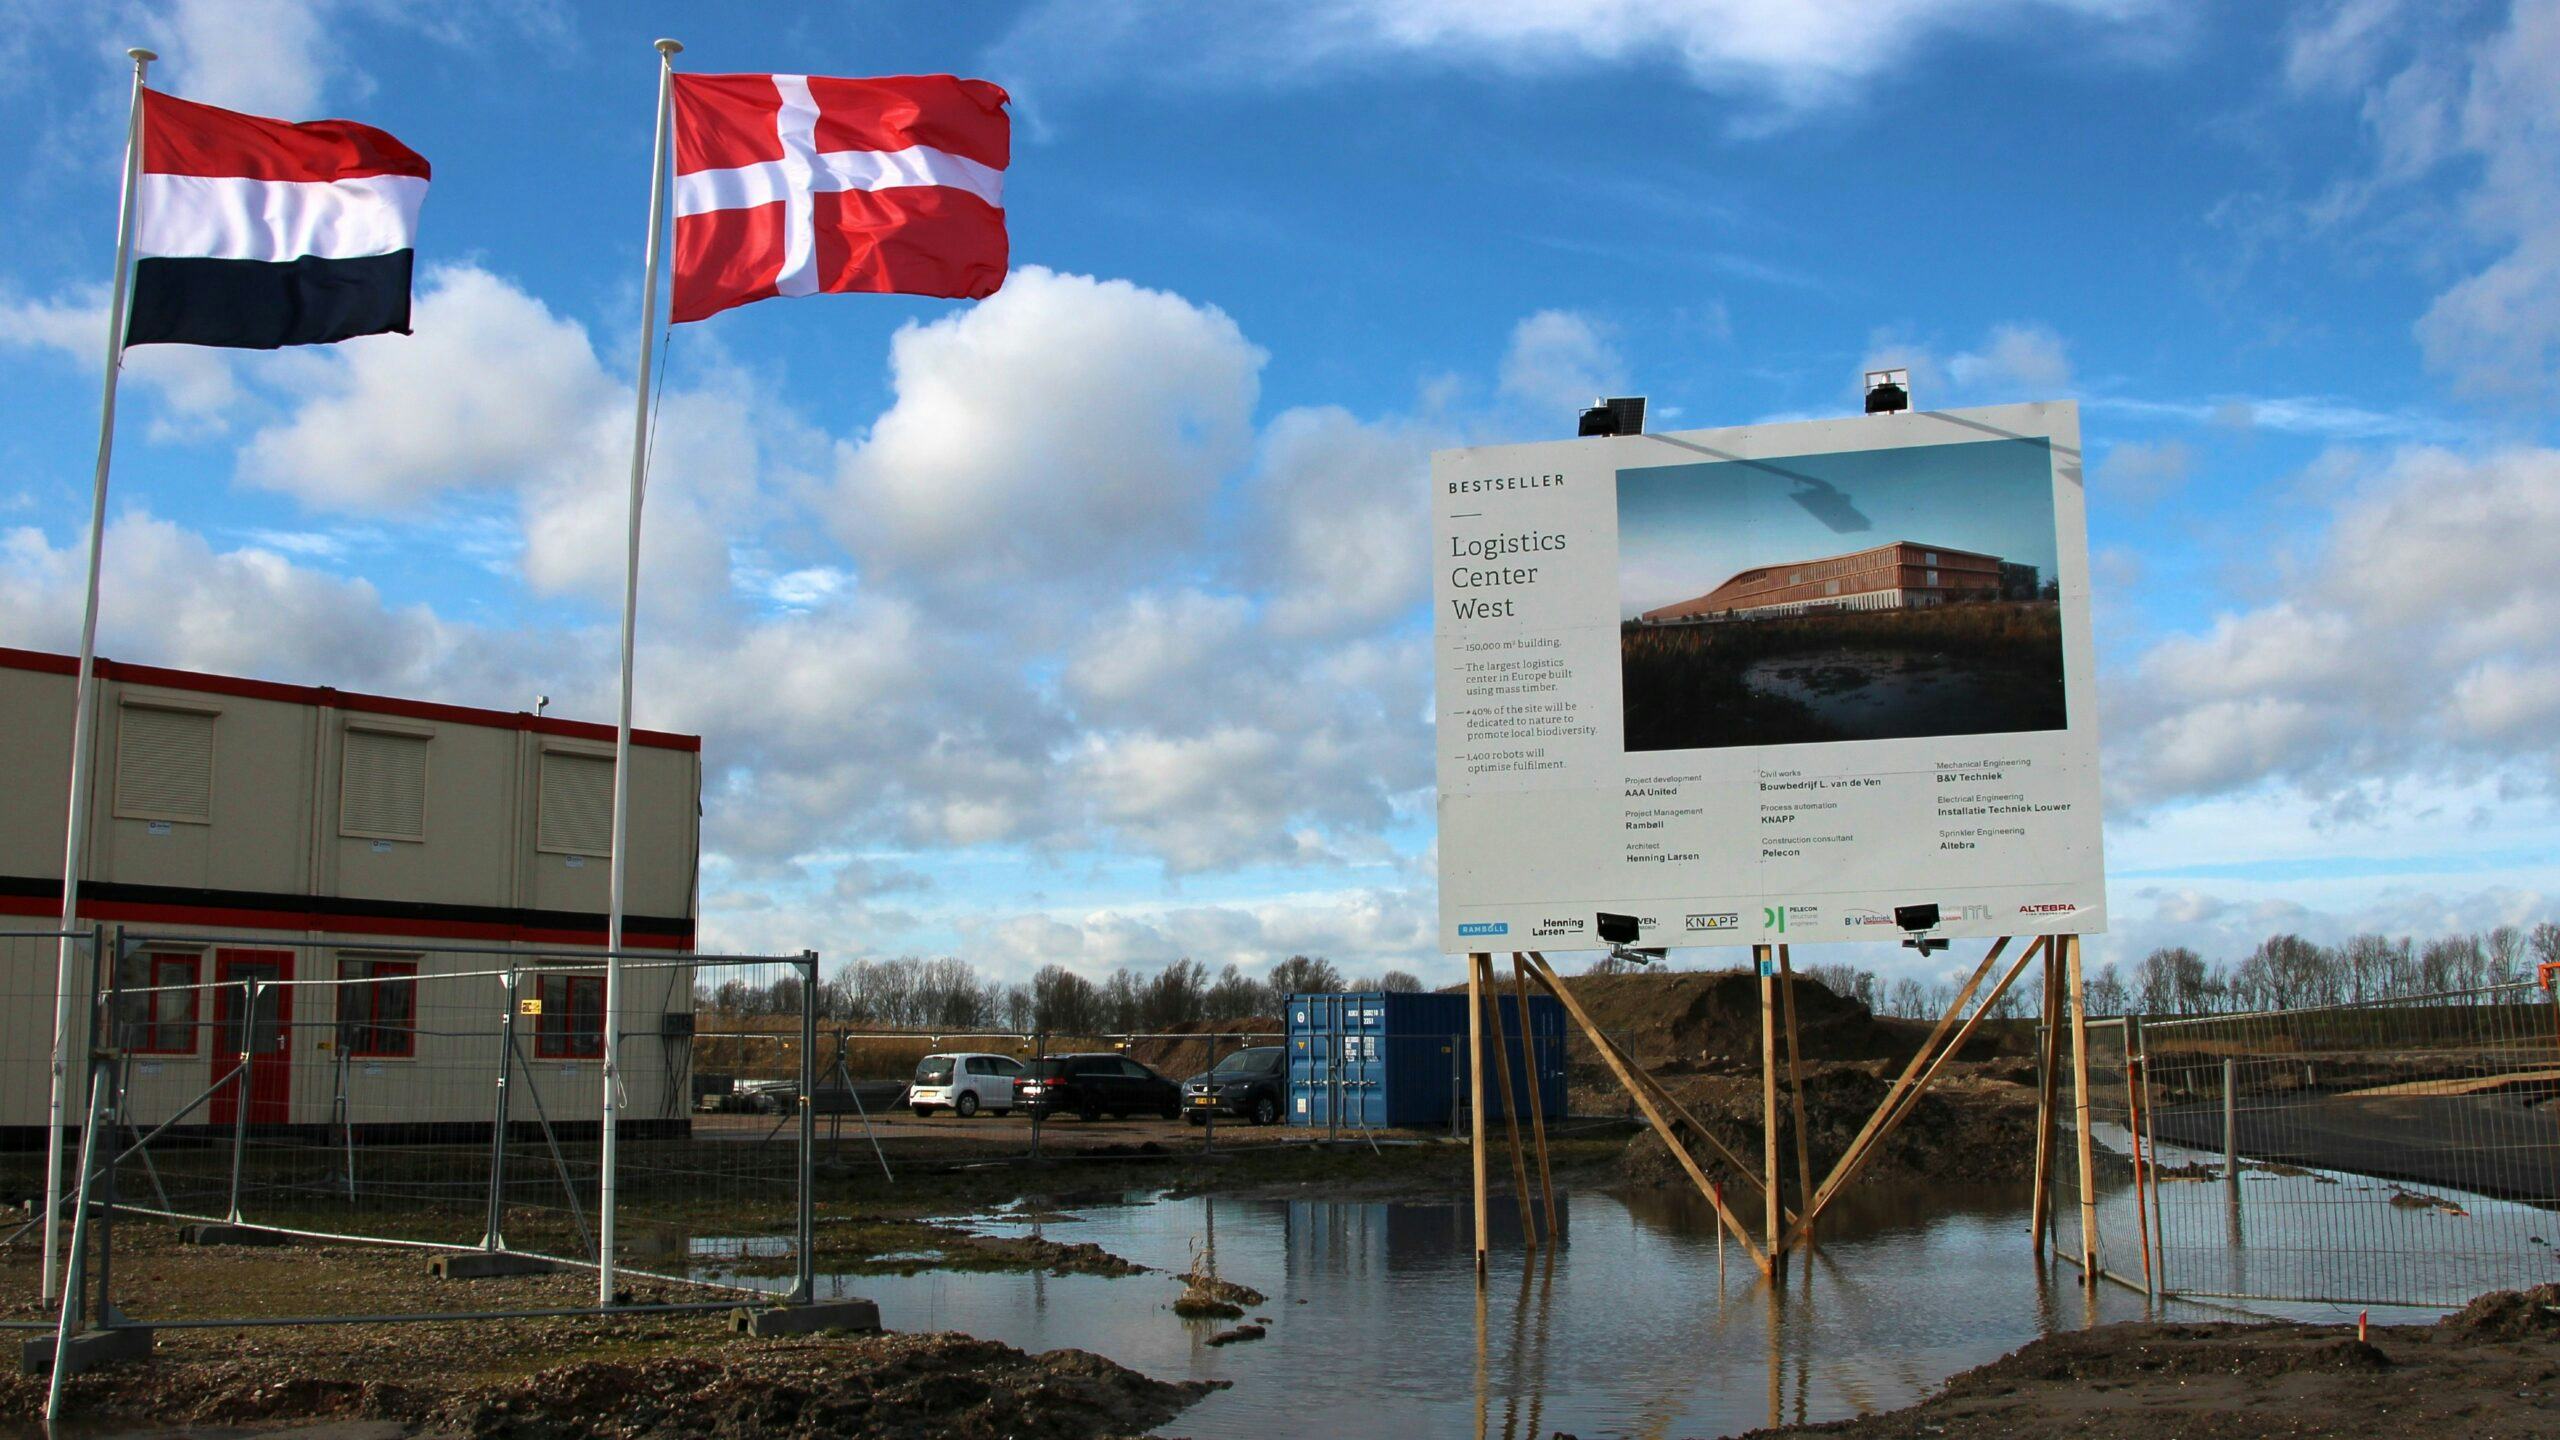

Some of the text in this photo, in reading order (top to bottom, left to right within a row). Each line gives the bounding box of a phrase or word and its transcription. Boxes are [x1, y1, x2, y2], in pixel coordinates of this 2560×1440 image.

[1449, 474, 1564, 494] BESTSELLER
[1452, 531, 1566, 560] Logistics
[1452, 567, 1538, 588] Center
[1452, 598, 1514, 620] West
[1465, 659, 1564, 672] The largest logistics
[1465, 669, 1572, 684] center in Europe built
[1466, 683, 1558, 697] using mass timber.
[1494, 706, 1506, 715] of
[1507, 704, 1523, 714] the
[1525, 704, 1542, 712] site
[1544, 702, 1563, 712] will
[1565, 702, 1576, 711] be
[1467, 715, 1574, 728] dedicated to nature to
[1467, 725, 1598, 742] promote local biodiversity.
[1492, 749, 1524, 759] robots
[1526, 748, 1544, 758] will
[1468, 762, 1511, 774] optimise
[1936, 758, 2031, 770] Mechanical Engineering
[1625, 774, 1702, 785] Project development
[1760, 770, 1777, 778] Civil
[1936, 772, 2002, 783] B&V Techniek
[1760, 780, 1818, 791] Bouwbedrijf
[1819, 780, 1828, 788] L.
[1850, 778, 1862, 787] de
[1864, 778, 1881, 787] Ven
[1625, 787, 1677, 797] AAA United
[1937, 793, 2024, 804] Electrical Engineering
[1625, 807, 1703, 818] Project Management
[1760, 802, 1837, 812] Process automation
[1938, 802, 2071, 816] Installatie Techniek Louwer
[1761, 815, 1795, 824] KNAPP
[1939, 827, 2025, 839] Sprinkler Engineering
[1762, 834, 1853, 845] Construction consultant
[1626, 842, 1659, 850] Architect
[1940, 841, 1975, 850] Altebra
[1626, 852, 1699, 863] Henning Larsen
[1762, 848, 1800, 857] Pelecon
[2020, 904, 2076, 912] ALTEBRA
[1544, 918, 1584, 928] Henning
